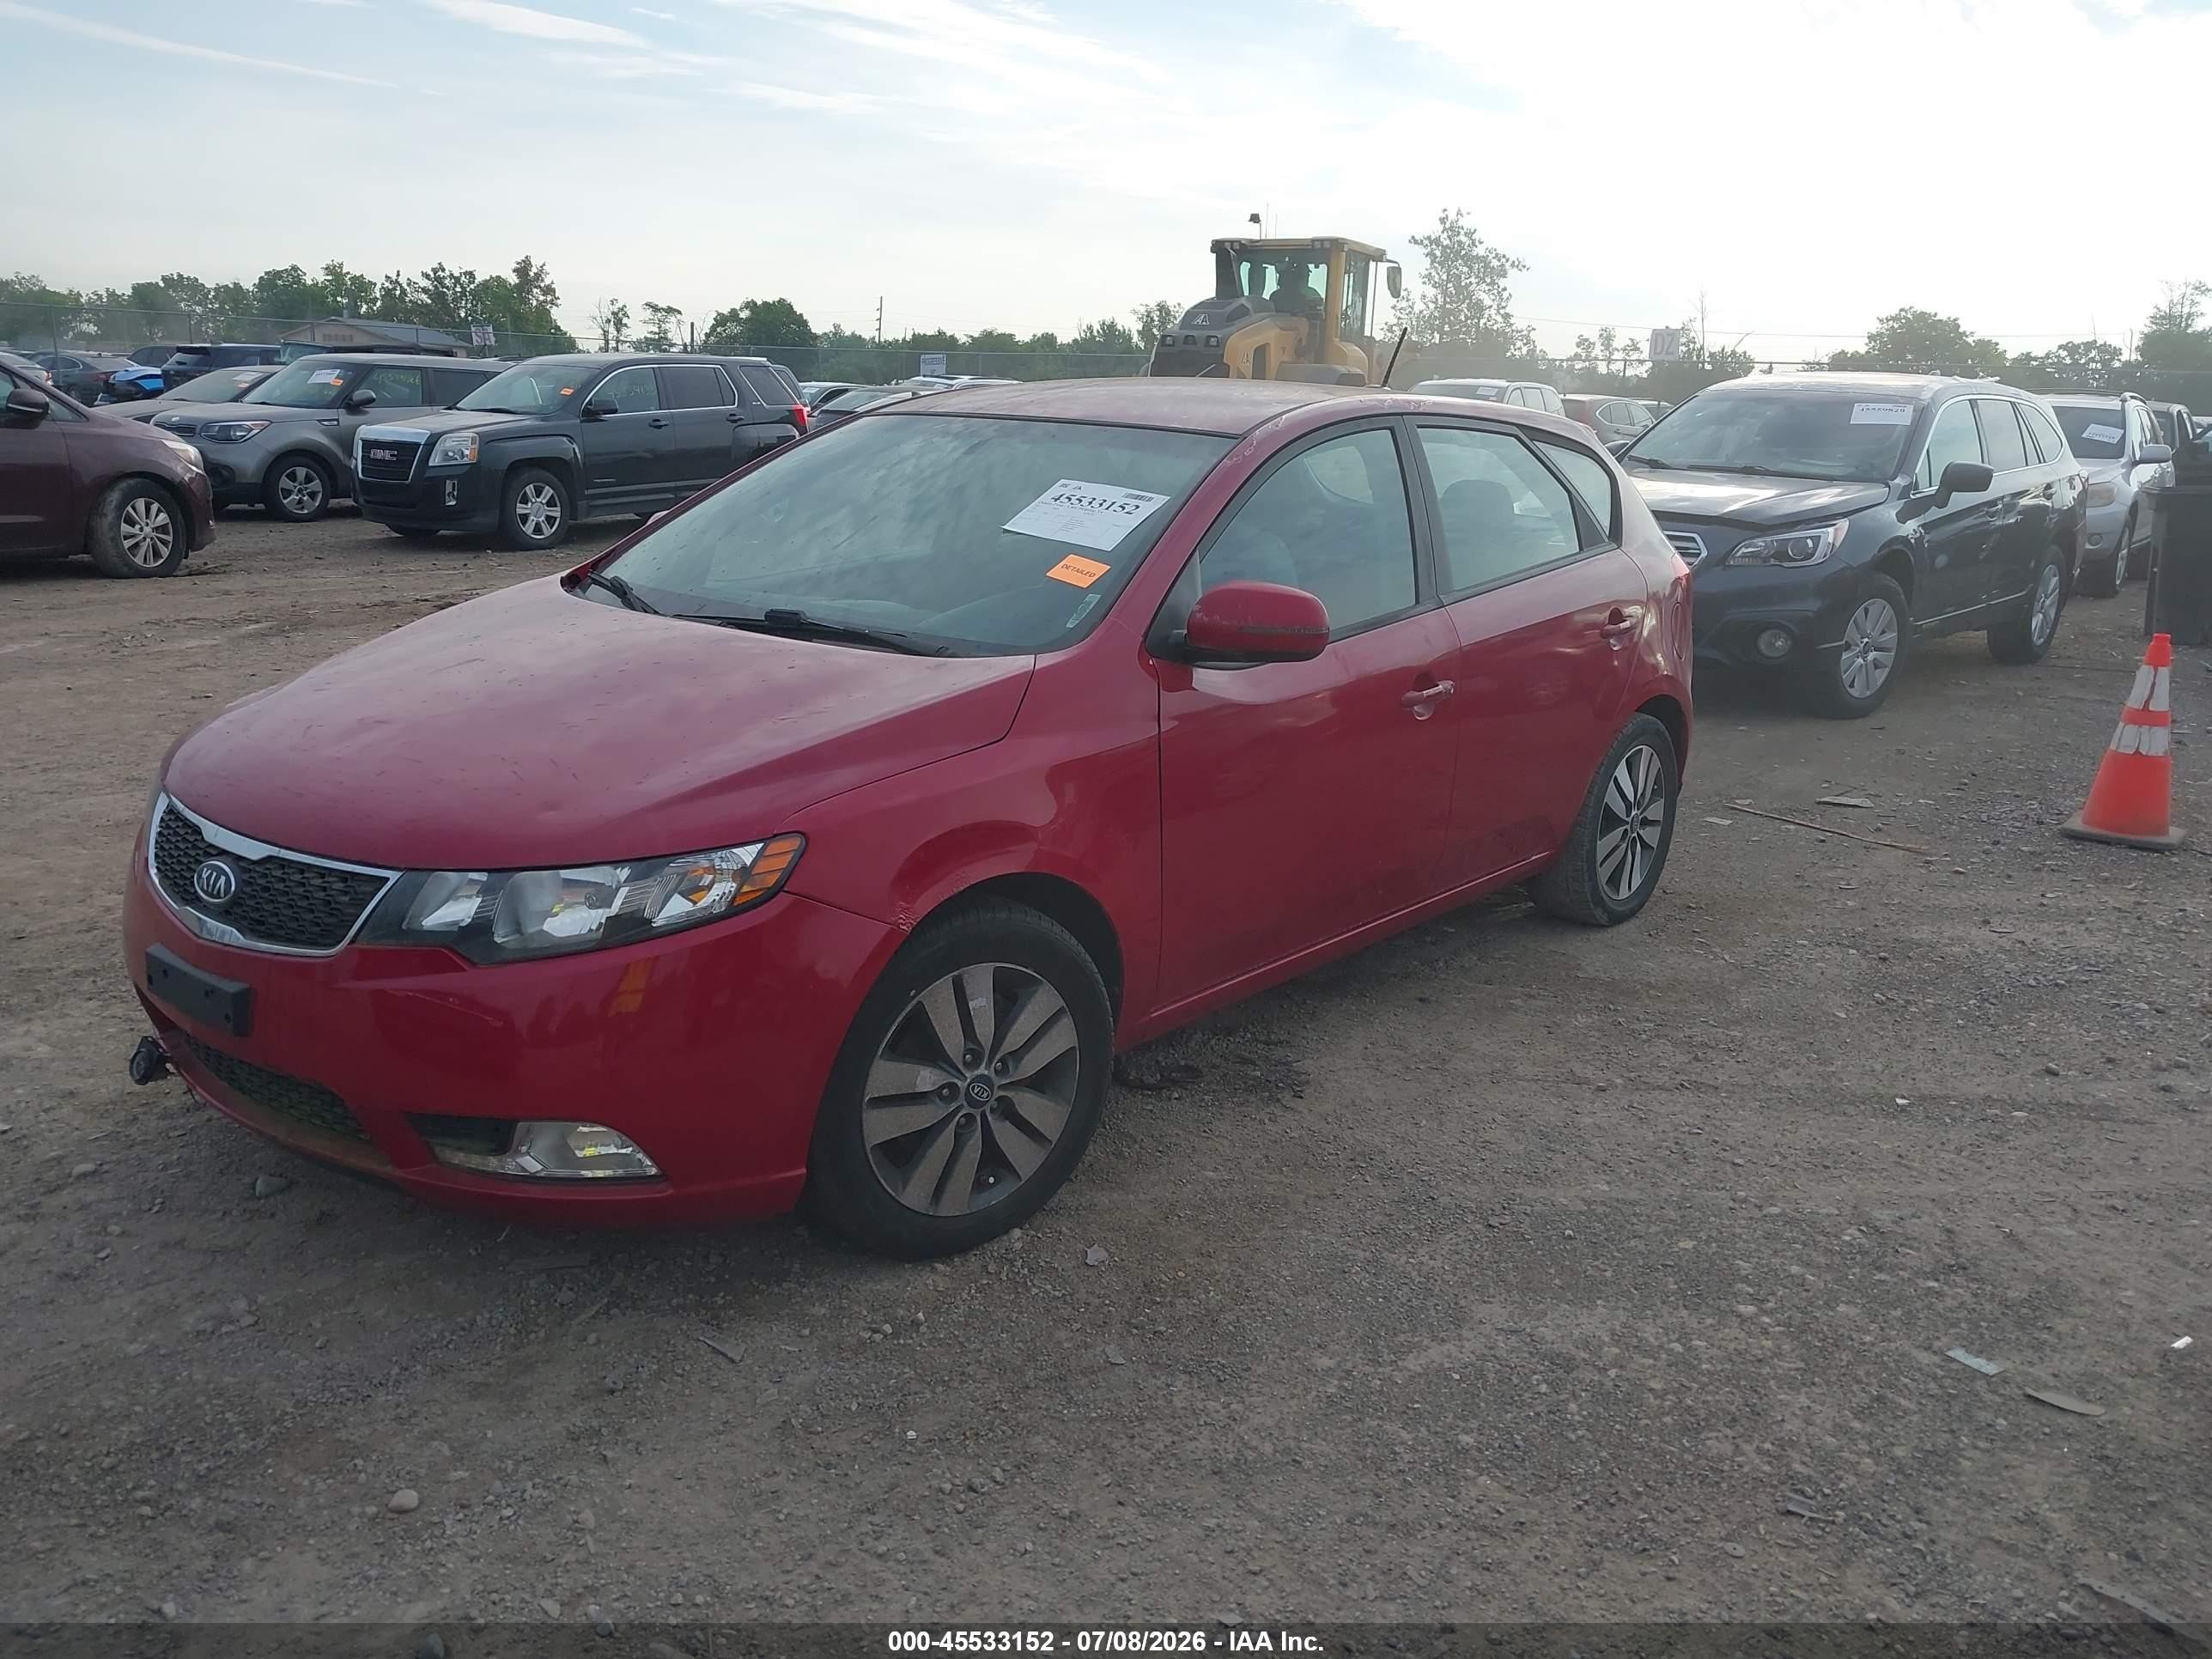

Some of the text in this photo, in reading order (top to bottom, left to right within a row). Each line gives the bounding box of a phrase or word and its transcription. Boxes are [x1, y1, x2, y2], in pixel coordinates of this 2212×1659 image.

[1653, 332, 1675, 356] DZ
[1051, 493, 1140, 514] 45533152
[1060, 563, 1097, 578] DETAILED
[199, 867, 226, 898] KIA
[973, 1085, 989, 1099] KIA
